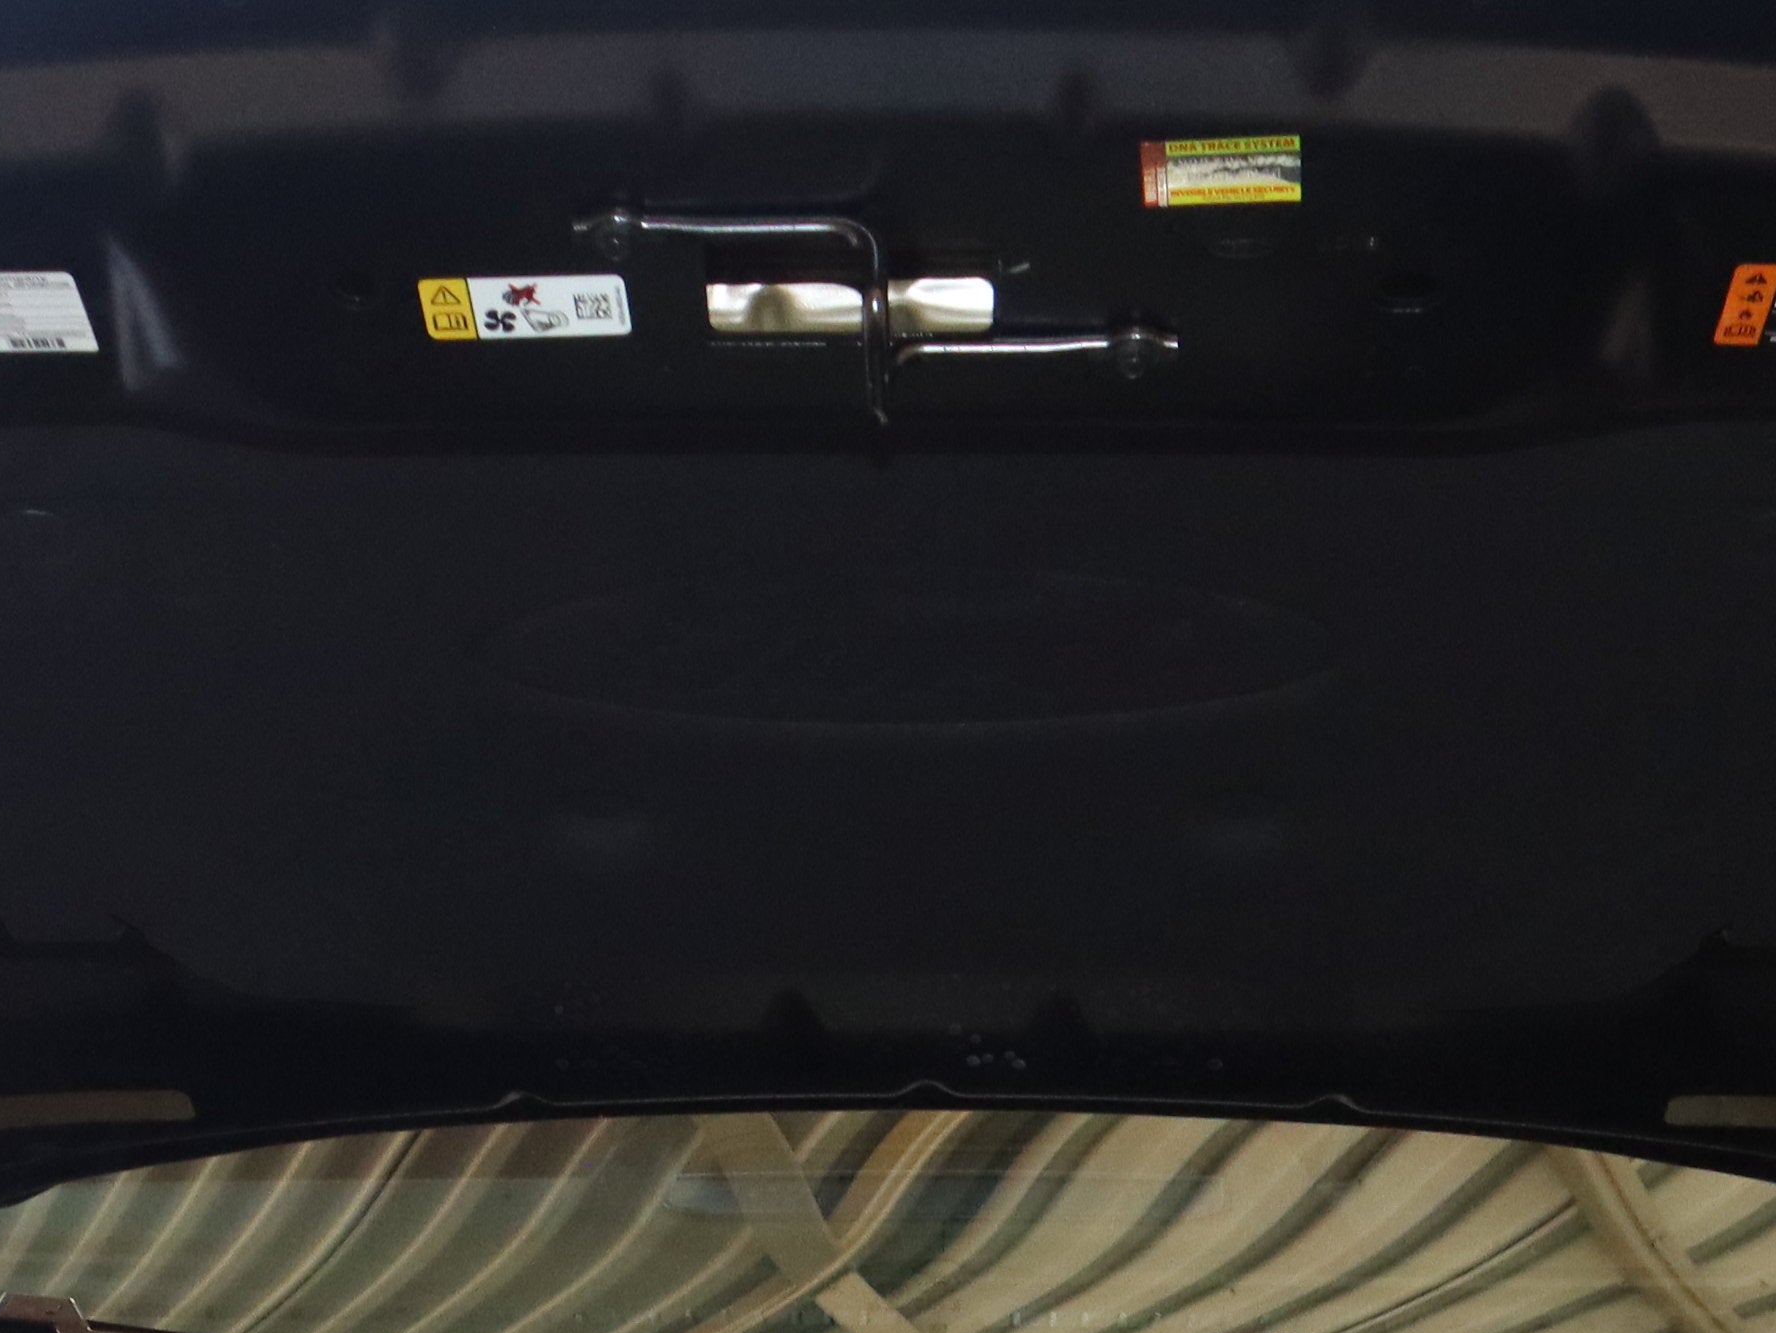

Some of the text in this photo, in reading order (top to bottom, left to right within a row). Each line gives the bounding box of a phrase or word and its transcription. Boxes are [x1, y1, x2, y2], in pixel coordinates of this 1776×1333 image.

[1168, 137, 1296, 153] DNA TRACE SYSTEM
